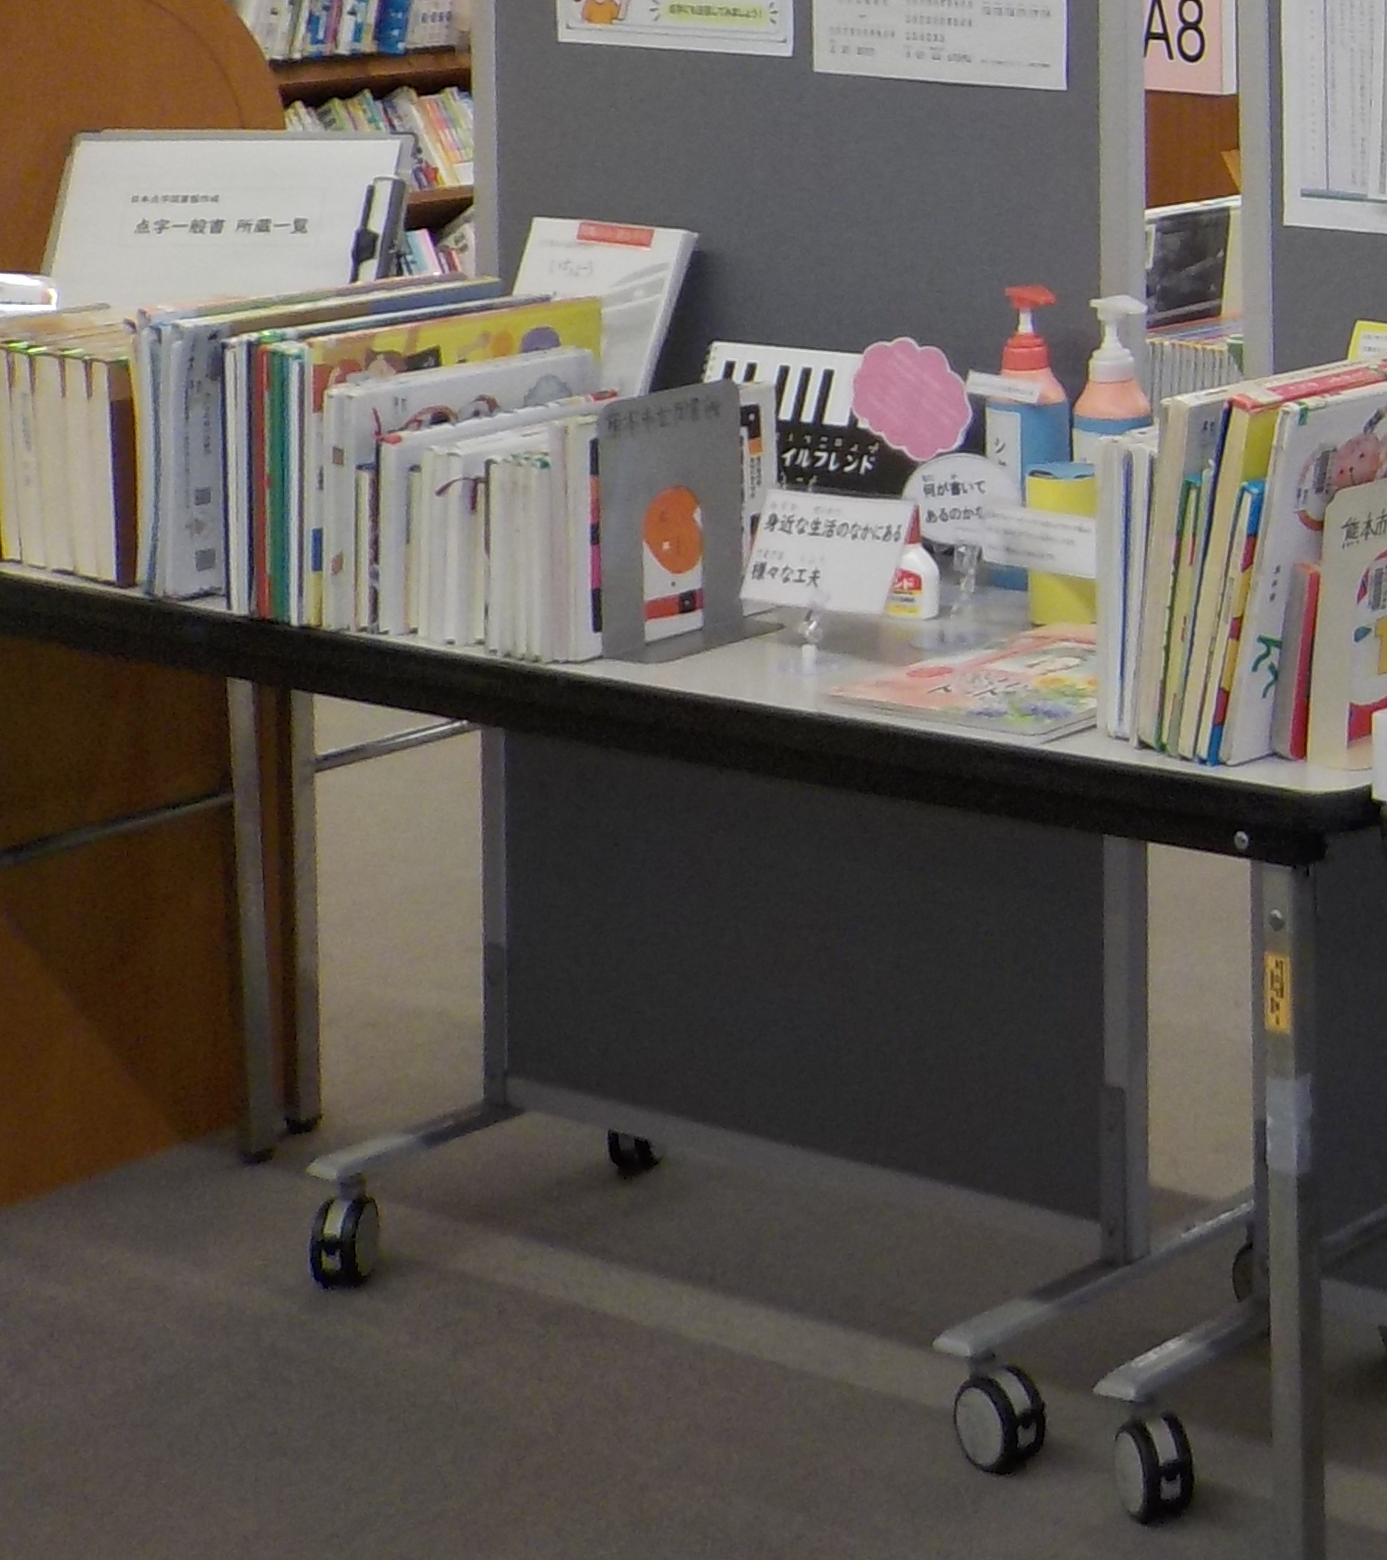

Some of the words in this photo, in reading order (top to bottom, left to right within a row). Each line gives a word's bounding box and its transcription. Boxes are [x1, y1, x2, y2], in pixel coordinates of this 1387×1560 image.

[133, 217, 226, 235] 点字一般書
[234, 217, 309, 235] 所蔵一覧
[923, 480, 987, 497] 何が書いて
[763, 513, 903, 543] 身近な生活のなかにある
[750, 561, 822, 588] 様々な工夫
